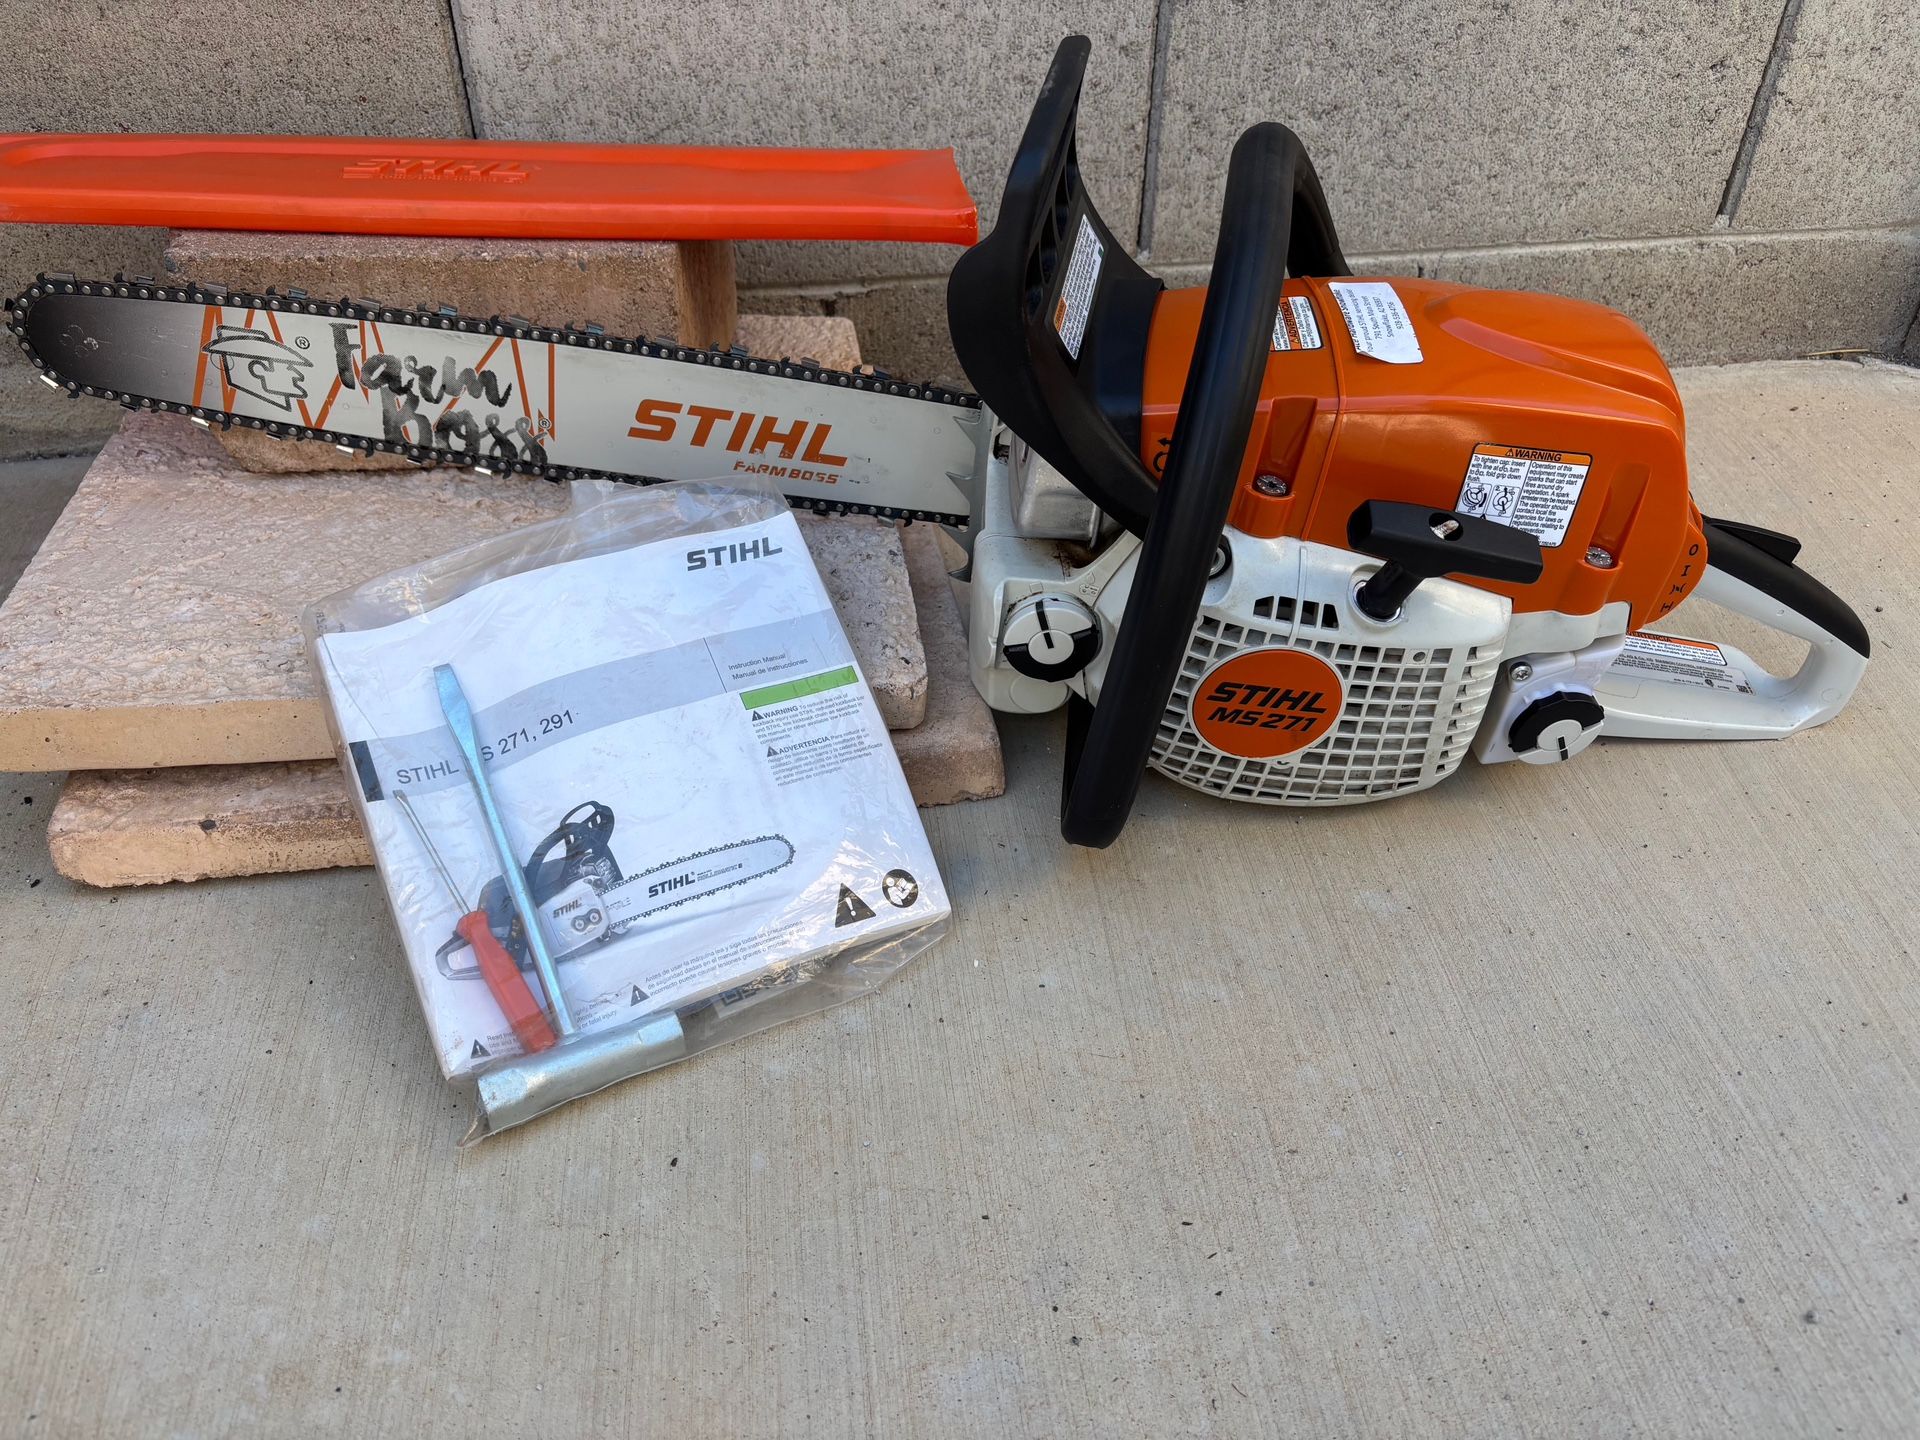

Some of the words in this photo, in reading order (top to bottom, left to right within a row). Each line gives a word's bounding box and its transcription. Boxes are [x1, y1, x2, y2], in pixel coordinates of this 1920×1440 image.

[1280, 302, 1298, 338] ADVERTENCIA
[328, 322, 512, 408] Farm
[627, 399, 848, 467] STIHL
[1515, 449, 1562, 461] WARNING
[733, 461, 787, 478] FARM
[788, 469, 839, 485] BOSS
[1529, 470, 1557, 478] equipment
[1531, 462, 1558, 471] Operation
[1529, 502, 1551, 510] operator
[1511, 520, 1540, 529] regulations
[1514, 514, 1538, 522] agencies
[687, 537, 783, 571] STIHL
[729, 658, 762, 671] Instruction
[762, 653, 786, 663] Manual
[733, 669, 757, 680] Manual
[768, 658, 808, 672] instrucciones
[1206, 682, 1327, 714] STIHL
[764, 705, 798, 719] WARNING
[1208, 707, 1264, 726] MS
[1259, 713, 1317, 732] 271
[396, 759, 460, 785] STIHL
[498, 729, 537, 756] 271,
[539, 709, 575, 735] 291
[779, 736, 830, 754] ADVERTENCIA
[649, 874, 695, 898] STIHL
[553, 899, 583, 919] STIHL
[684, 964, 703, 974] dadas
[718, 950, 740, 961] manual
[678, 974, 698, 984] puede
